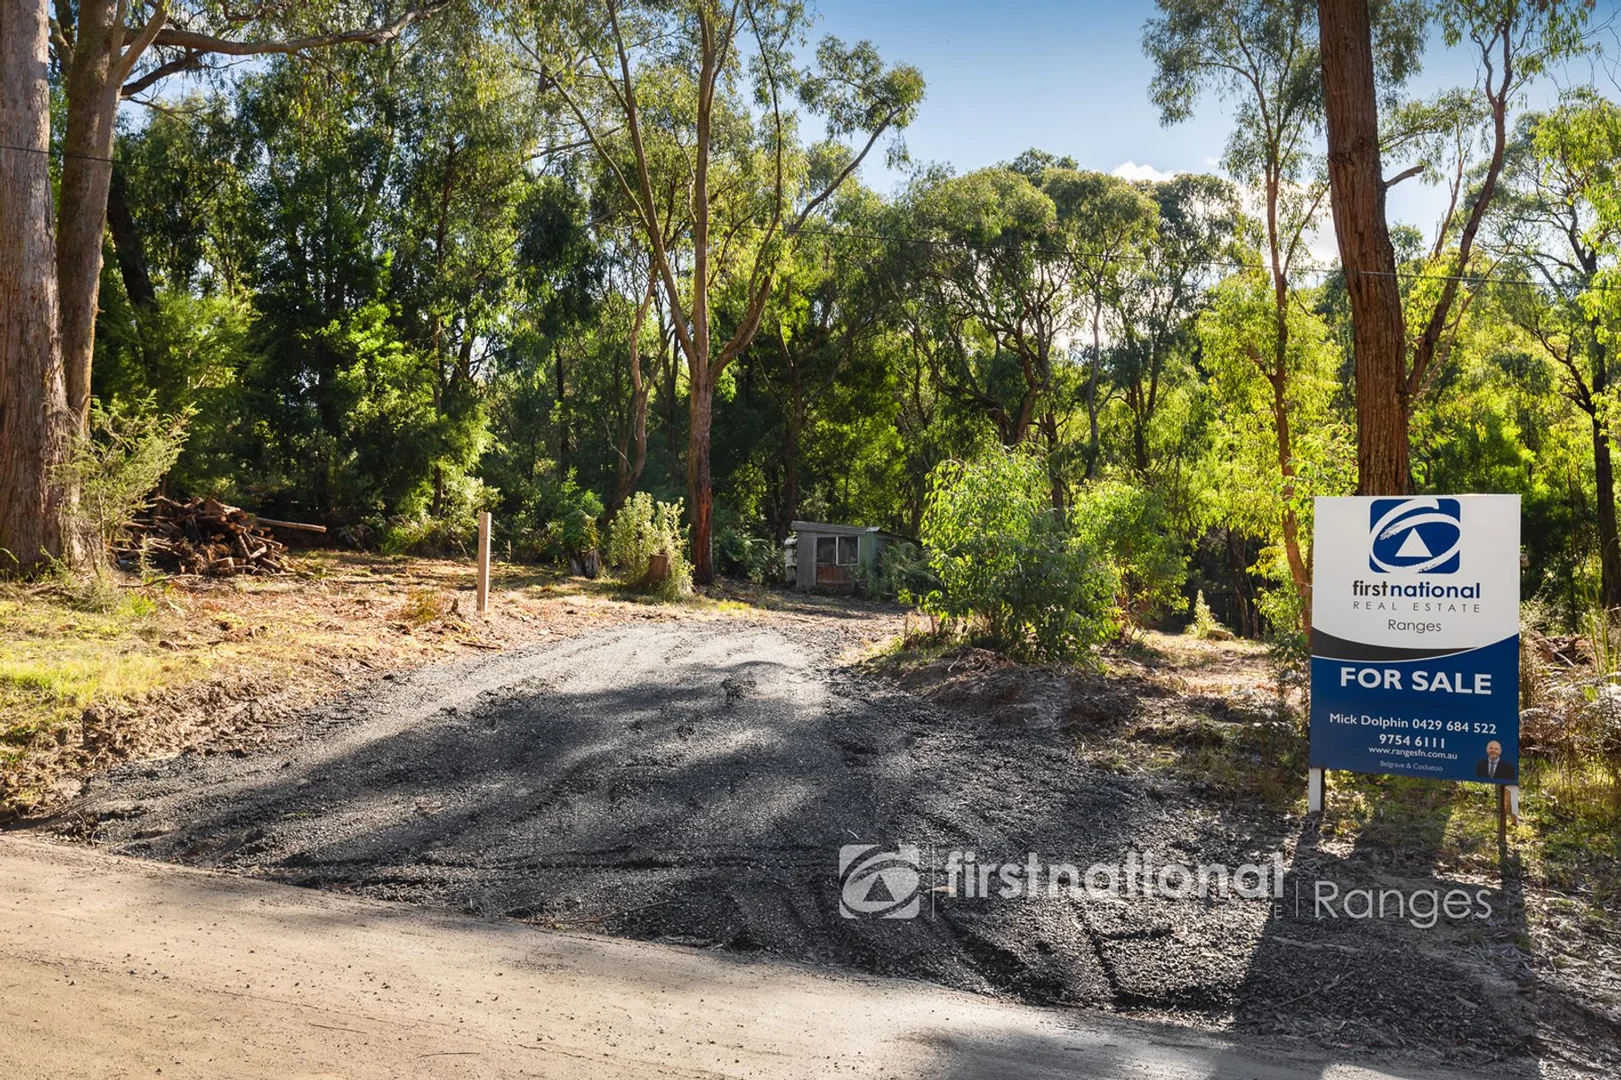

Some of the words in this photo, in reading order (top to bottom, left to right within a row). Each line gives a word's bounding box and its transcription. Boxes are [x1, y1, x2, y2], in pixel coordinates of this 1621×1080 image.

[1353, 601, 1398, 611] REAL
[1413, 602, 1481, 613] ESTATE
[1388, 619, 1442, 634] Ranges
[1340, 666, 1403, 690] FOR
[1412, 670, 1493, 695] SALE
[1329, 713, 1357, 725] Mick
[1361, 715, 1409, 730] Dolphin
[1412, 718, 1442, 731] 0429
[1446, 720, 1469, 733] 684
[1473, 723, 1497, 735] 522
[1379, 734, 1411, 746] 9754
[1414, 736, 1445, 749] 6111
[1368, 747, 1458, 760] www.rangesfn.com.au
[1380, 760, 1405, 769] Belgrave
[1412, 763, 1444, 772] Cockatoo
